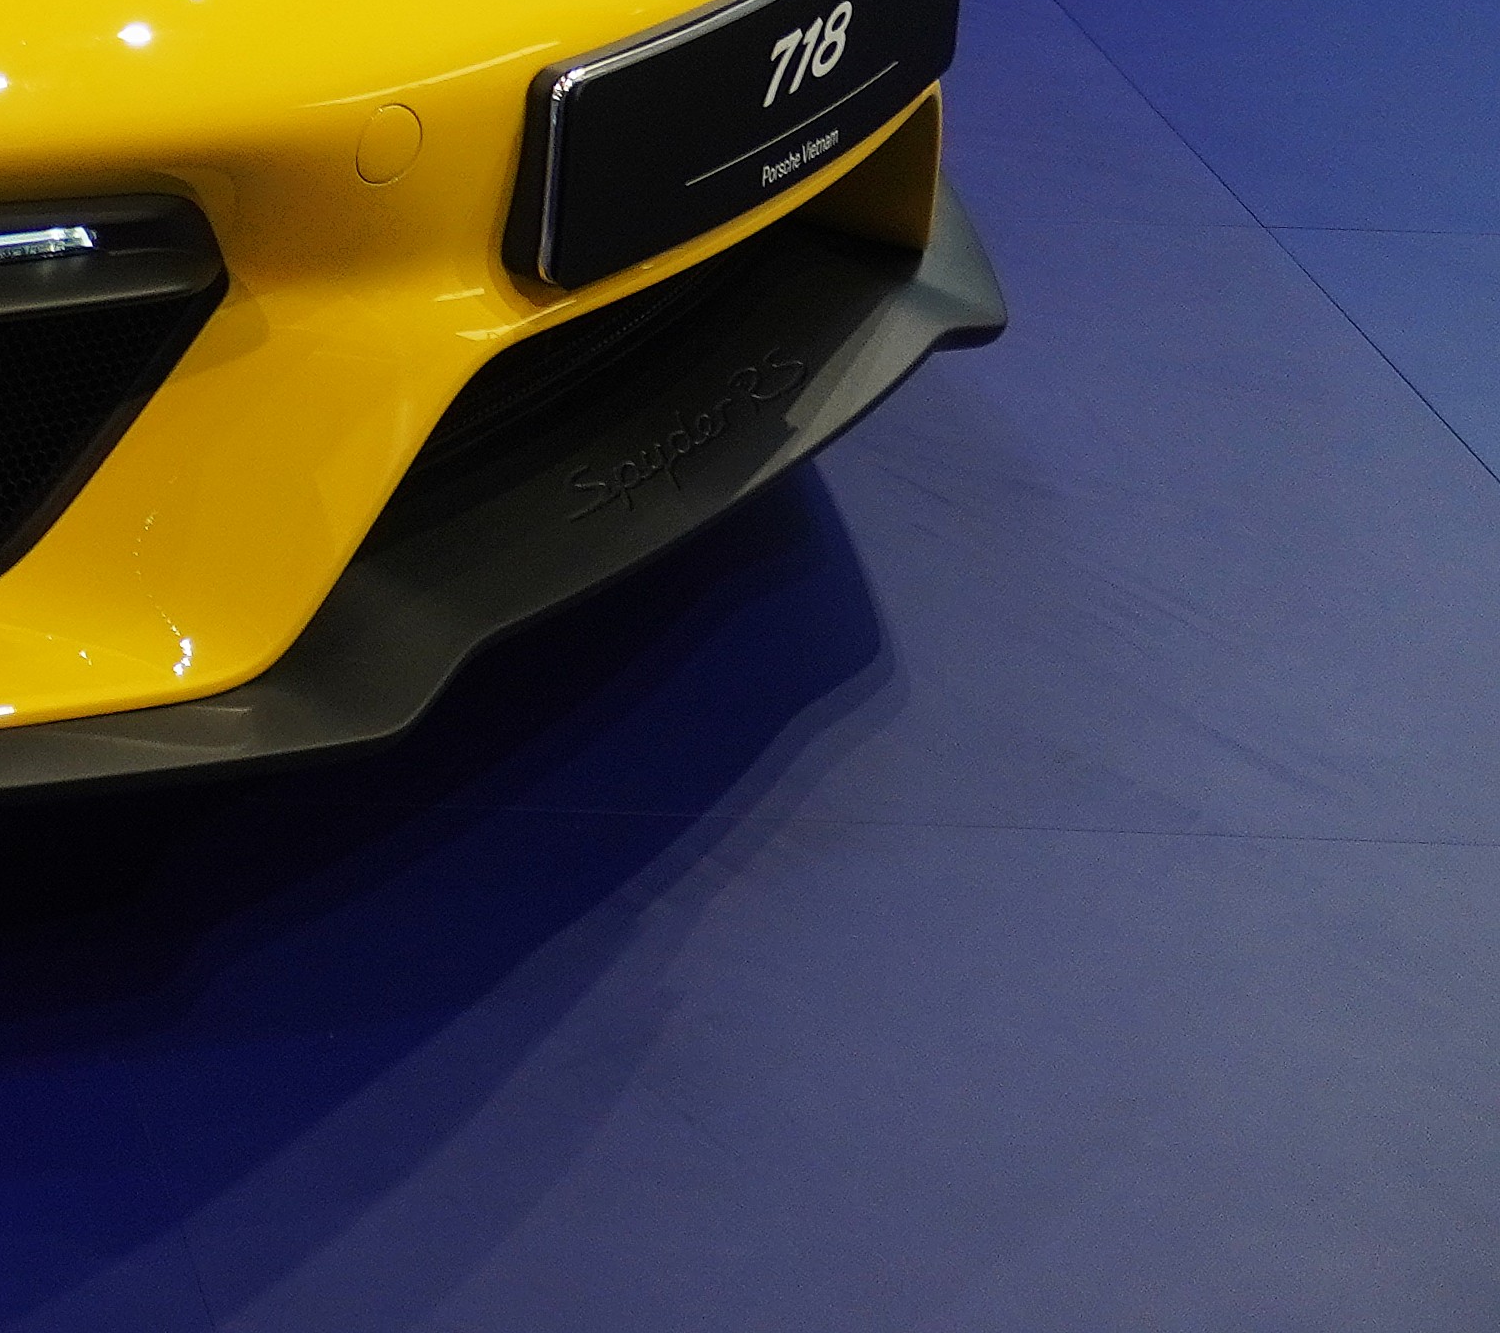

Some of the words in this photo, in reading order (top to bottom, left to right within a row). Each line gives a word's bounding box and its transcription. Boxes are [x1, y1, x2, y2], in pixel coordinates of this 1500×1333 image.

[762, 0, 853, 108] 718
[762, 152, 801, 187] Porsche
[802, 129, 839, 163] Vietnam
[563, 397, 732, 522] Spyder
